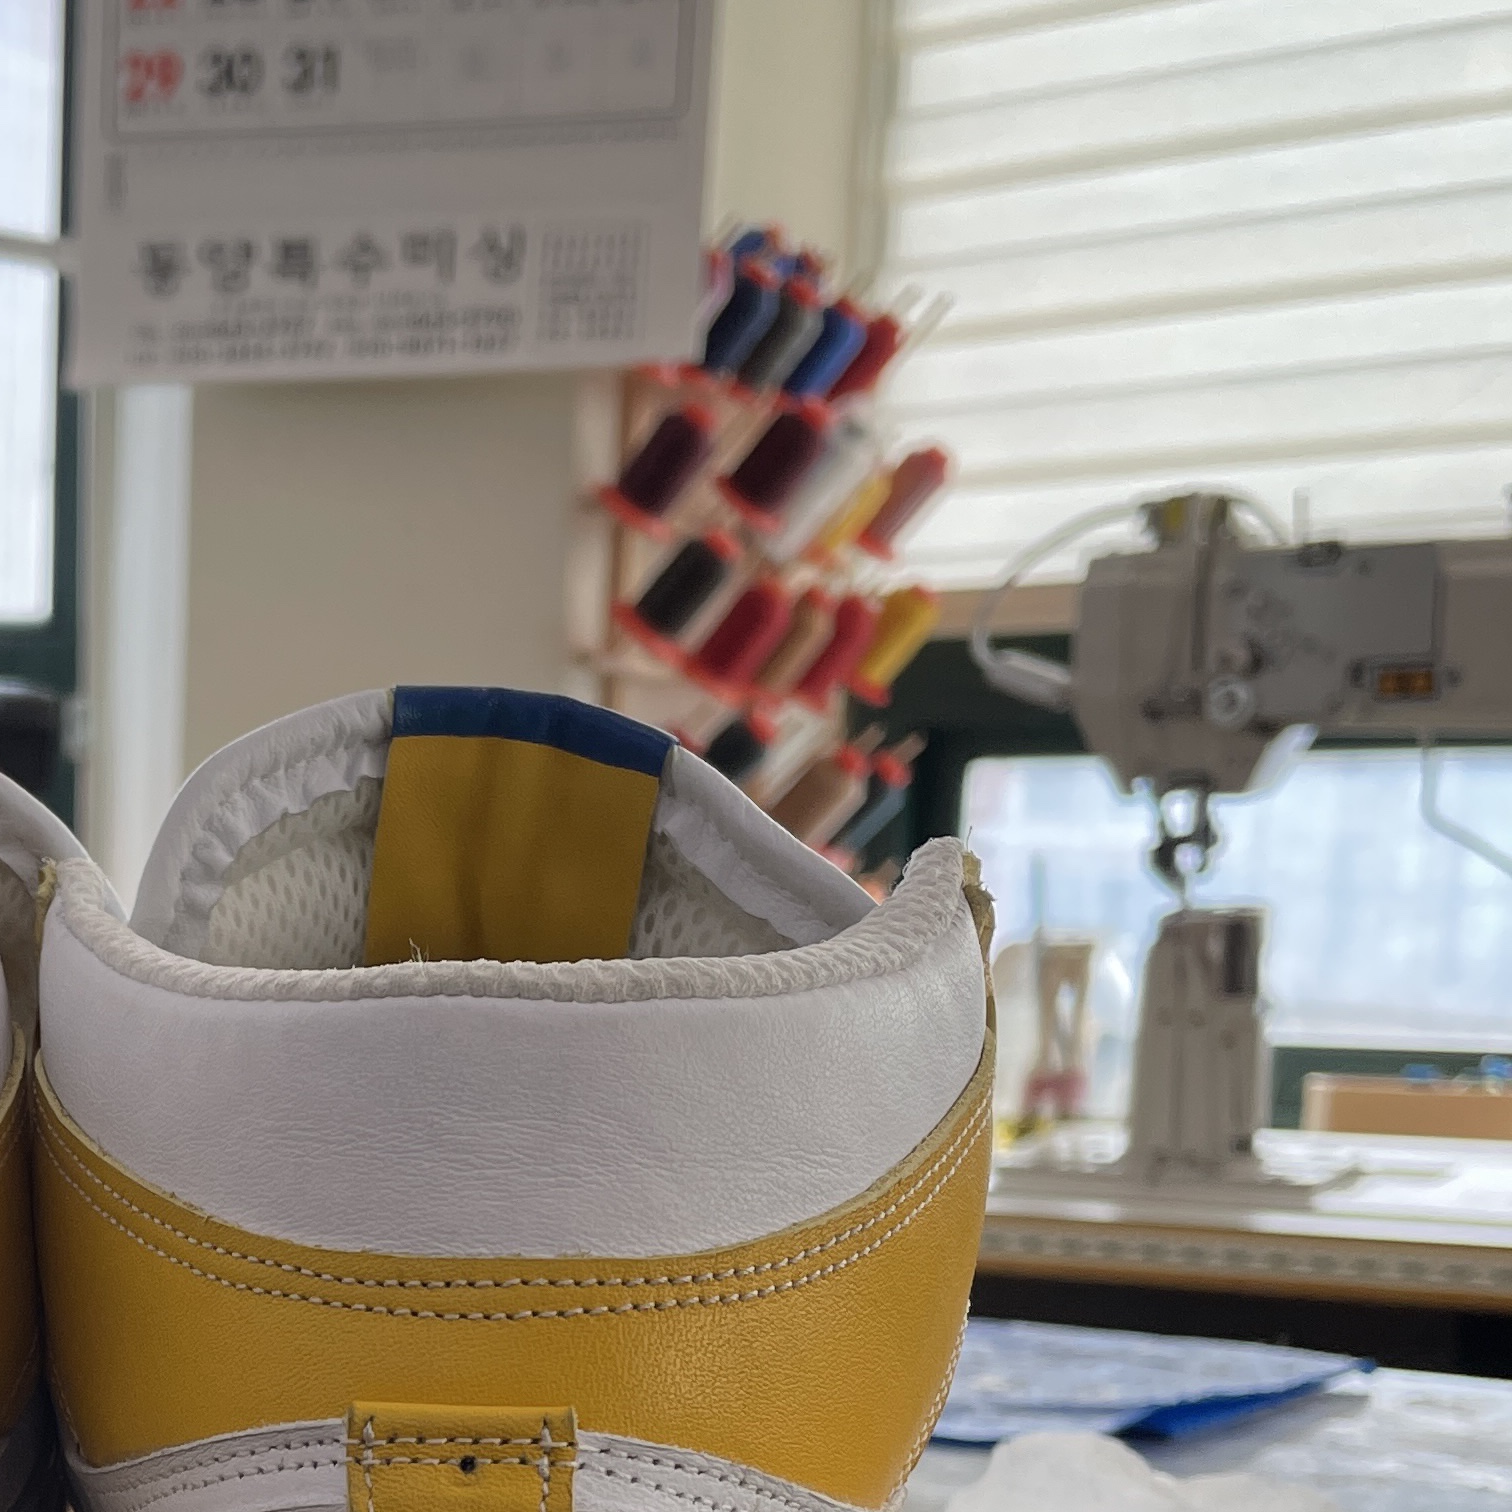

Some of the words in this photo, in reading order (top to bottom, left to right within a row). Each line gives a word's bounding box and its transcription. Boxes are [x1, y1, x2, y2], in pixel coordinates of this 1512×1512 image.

[123, 47, 184, 102] 29
[201, 44, 264, 97] 30
[283, 43, 341, 94] 31
